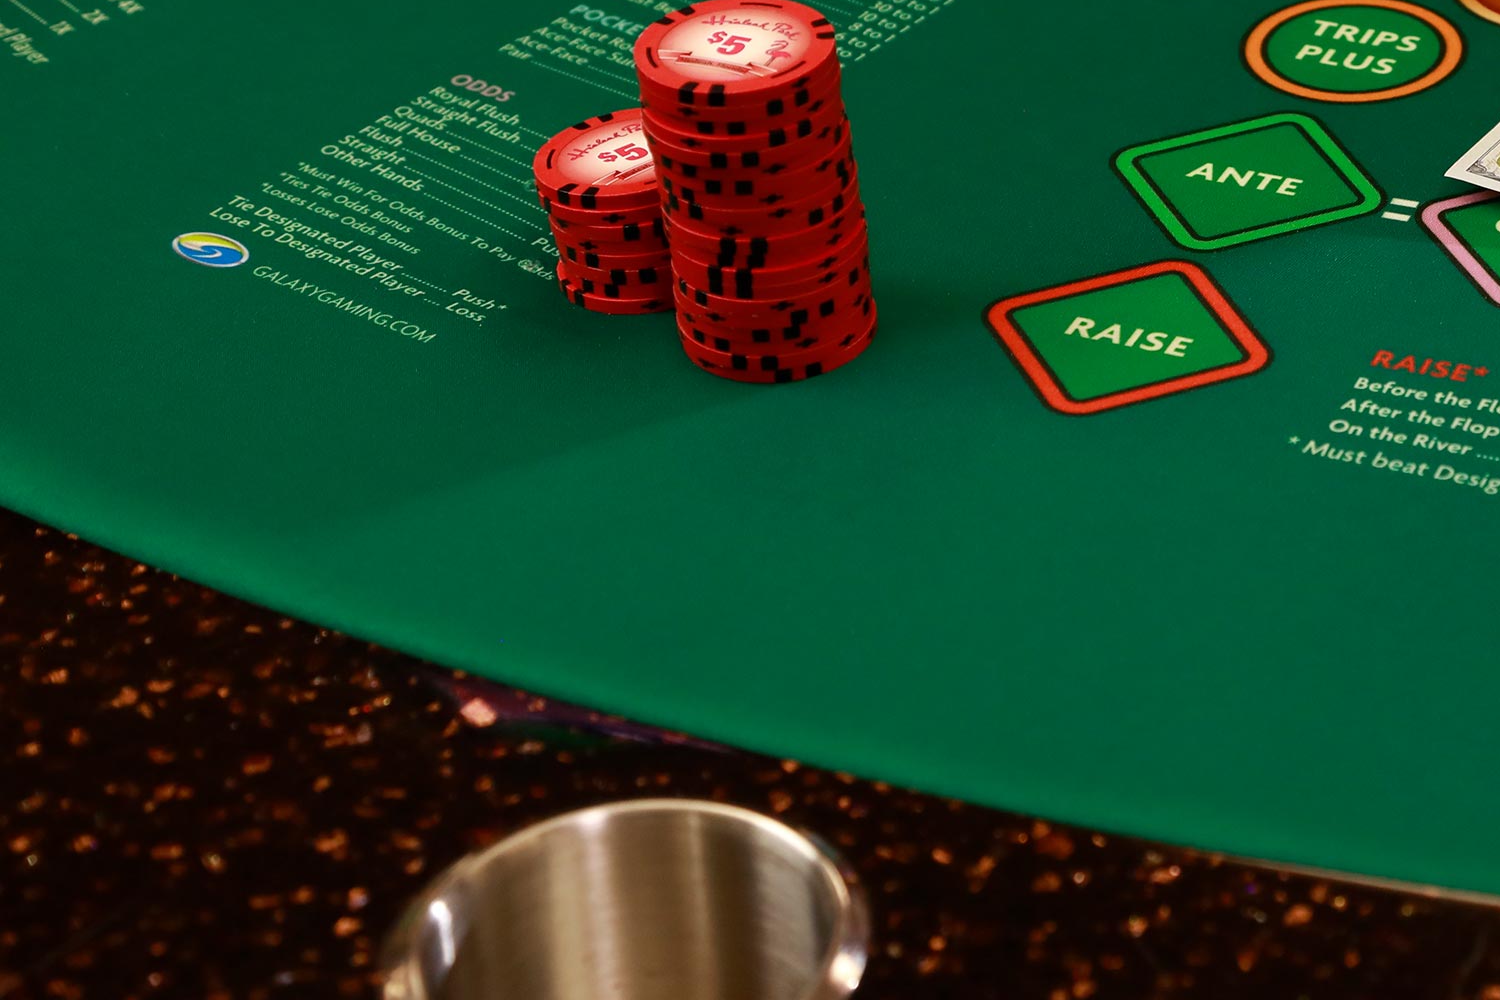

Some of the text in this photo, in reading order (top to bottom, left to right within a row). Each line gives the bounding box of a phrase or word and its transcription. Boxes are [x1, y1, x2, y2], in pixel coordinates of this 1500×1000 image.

[892, 9, 912, 20] to
[907, 0, 926, 11] to
[551, 16, 609, 41] Pocket
[862, 27, 882, 39] to
[878, 18, 897, 30] to
[1312, 18, 1421, 54] TRIPS
[498, 43, 533, 60] Pair
[707, 30, 752, 55] $5
[848, 37, 867, 48] to
[1294, 43, 1397, 77] PLUS
[429, 86, 520, 126] Royal Flush
[450, 74, 516, 102] ODDS
[358, 125, 403, 148] Flush
[374, 114, 461, 153] Full House
[394, 106, 447, 131] Quads
[410, 96, 521, 144] Straight Flush
[338, 134, 406, 165] Straight
[598, 142, 648, 163] $5
[320, 144, 372, 169] Other
[370, 163, 425, 192] Hands
[1185, 161, 1304, 198] ANTE
[311, 185, 332, 199] Tie
[333, 194, 371, 215] Odds
[369, 211, 414, 234] Bonus
[337, 177, 364, 194] Win
[363, 189, 388, 205] For
[388, 200, 426, 222] Odds
[425, 217, 470, 241] Bonus
[470, 236, 489, 250] To
[489, 246, 516, 262] Pay
[227, 194, 255, 212] Tie
[254, 206, 352, 250] Designated
[348, 245, 404, 272] Player
[306, 201, 340, 220] Lose
[340, 216, 378, 236] Odds
[377, 232, 422, 256] Bonus
[209, 207, 251, 228] Lose
[251, 222, 276, 238] To
[275, 233, 372, 276] Designated
[369, 270, 426, 298] Player
[253, 265, 436, 344] GALAXYGAMING.COM
[1063, 316, 1195, 360] RAISE
[1353, 376, 1428, 401] Before
[1434, 390, 1472, 409] the
[1340, 398, 1402, 419] After
[1407, 409, 1446, 431] the
[1451, 416, 1500, 440] Flop
[1328, 418, 1364, 437] On
[1369, 425, 1408, 445] the
[1412, 433, 1474, 457] River
[1302, 438, 1368, 467] Must
[1371, 451, 1430, 477] beat
